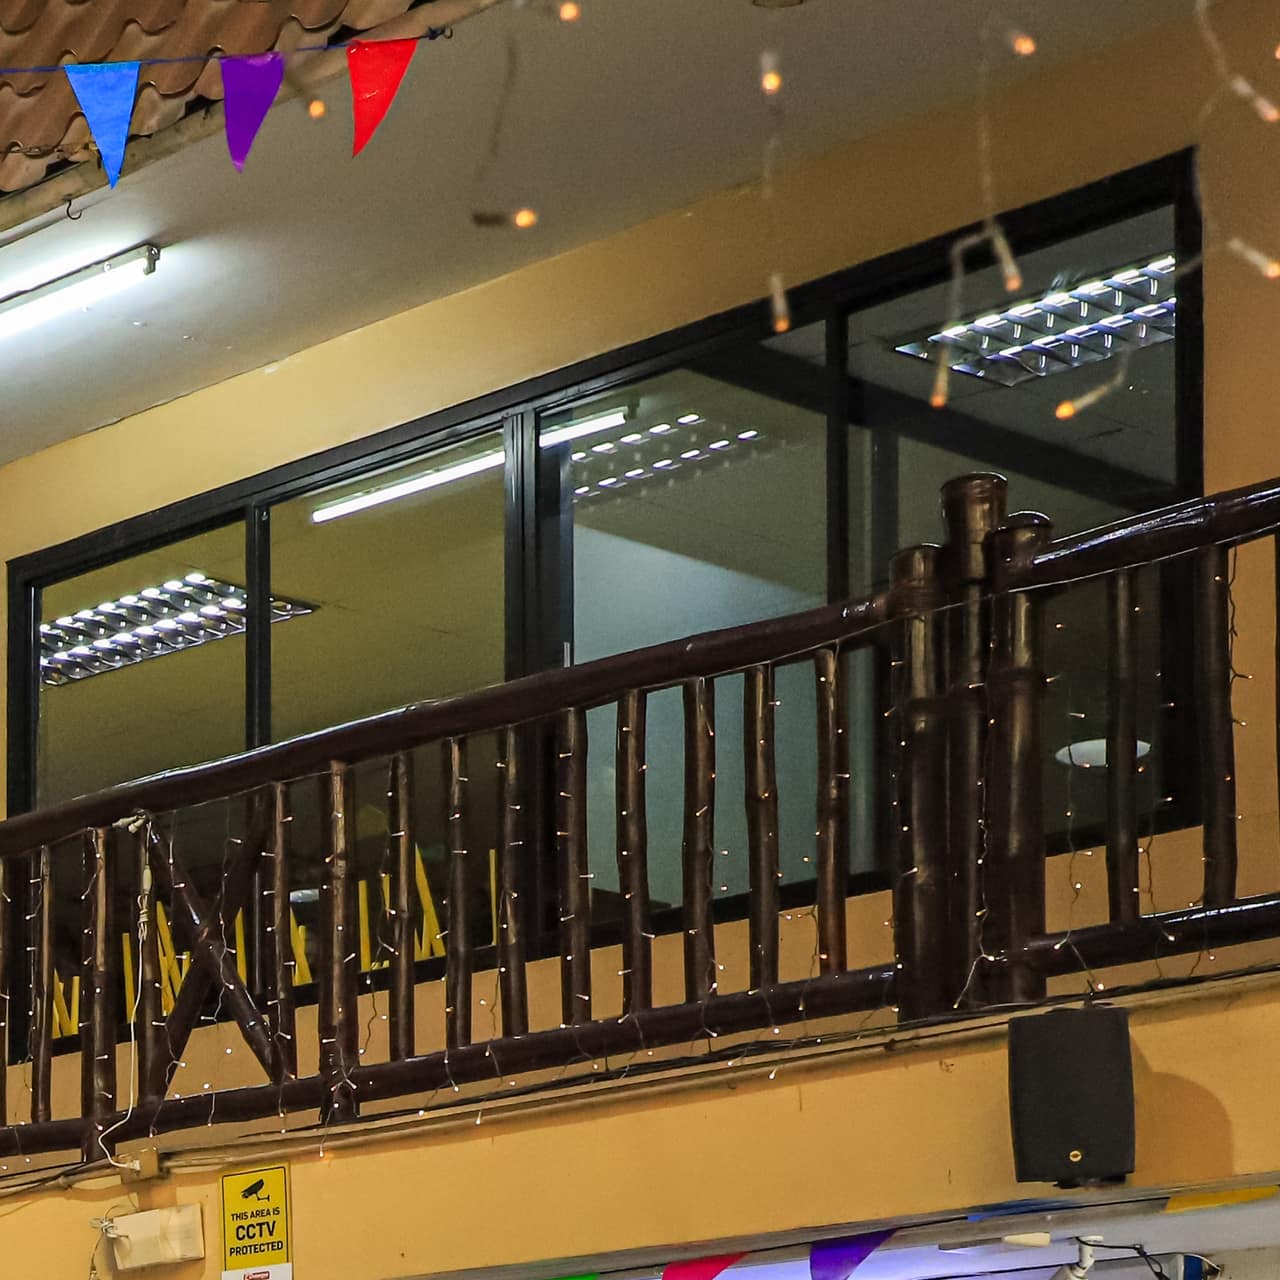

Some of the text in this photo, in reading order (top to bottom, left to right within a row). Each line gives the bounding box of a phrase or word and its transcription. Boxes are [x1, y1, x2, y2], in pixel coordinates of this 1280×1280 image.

[231, 1206, 281, 1222] THIS AREA IS
[235, 1220, 276, 1241] CCTV
[229, 1240, 284, 1256] PROTECTED
